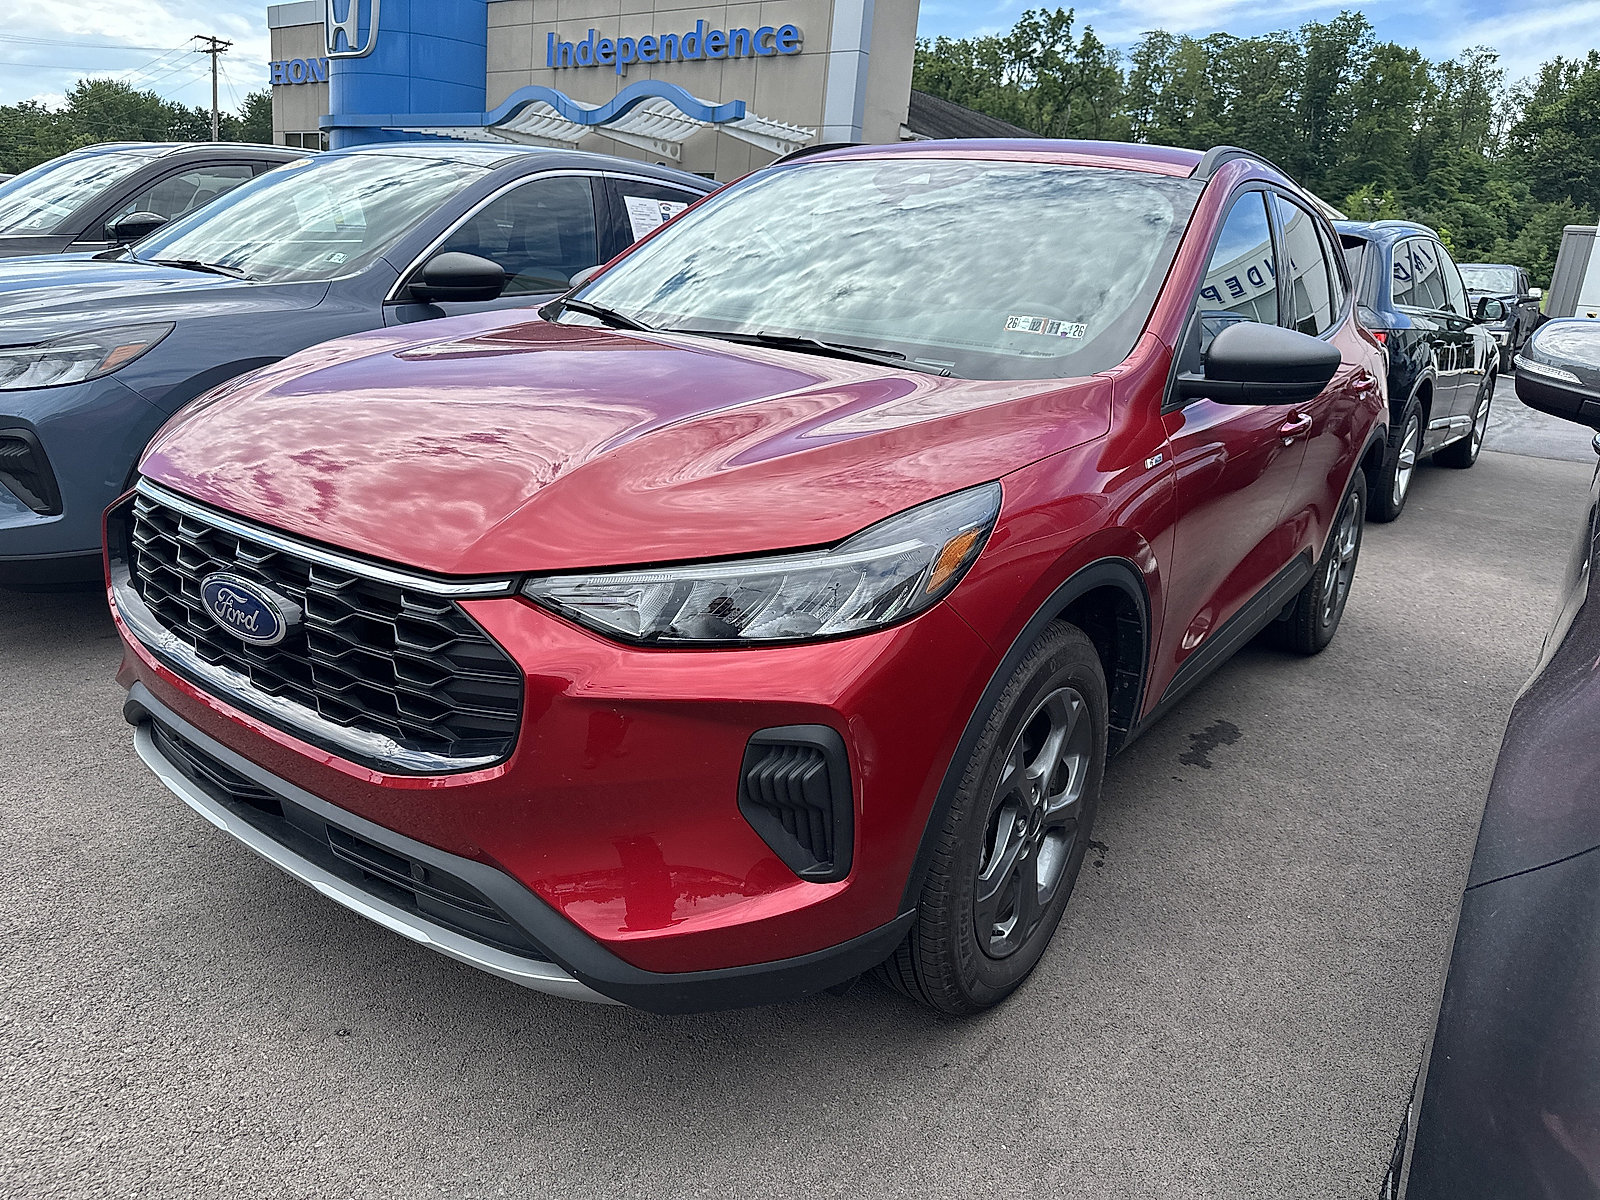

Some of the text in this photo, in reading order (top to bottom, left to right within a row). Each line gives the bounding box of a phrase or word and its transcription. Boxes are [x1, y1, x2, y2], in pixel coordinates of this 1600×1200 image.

[547, 19, 801, 76] Independence
[268, 58, 329, 85] HON
[1007, 317, 1019, 329] 26
[1072, 324, 1085, 337] 26
[214, 587, 259, 632] Ford
